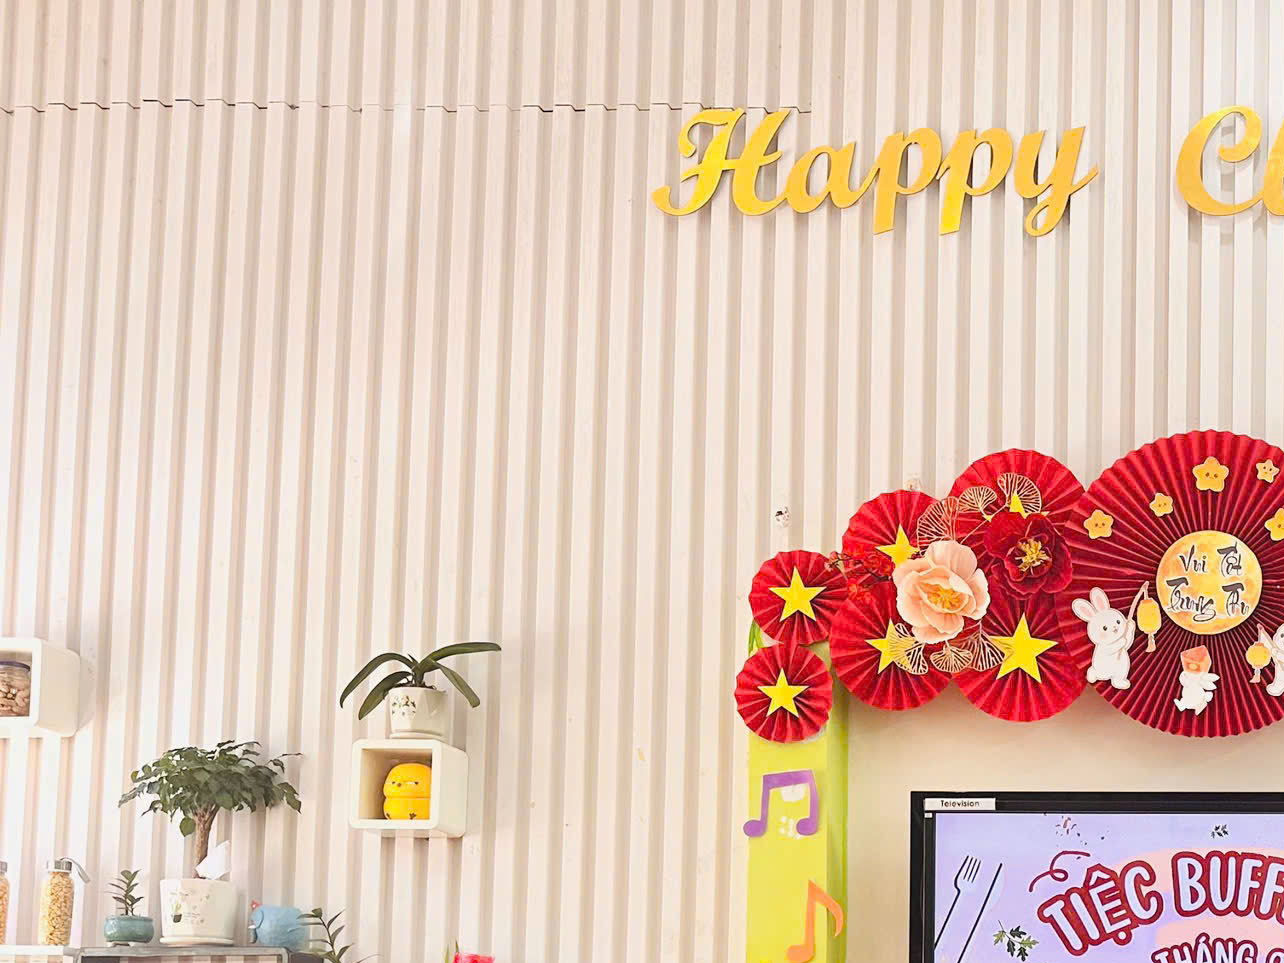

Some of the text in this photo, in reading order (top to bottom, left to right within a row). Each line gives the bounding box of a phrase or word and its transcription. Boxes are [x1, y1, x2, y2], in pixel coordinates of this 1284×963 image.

[651, 106, 1099, 237] Happy
[1179, 544, 1208, 573] Vui
[940, 799, 981, 808] Television
[1037, 860, 1164, 956] TIỆC
